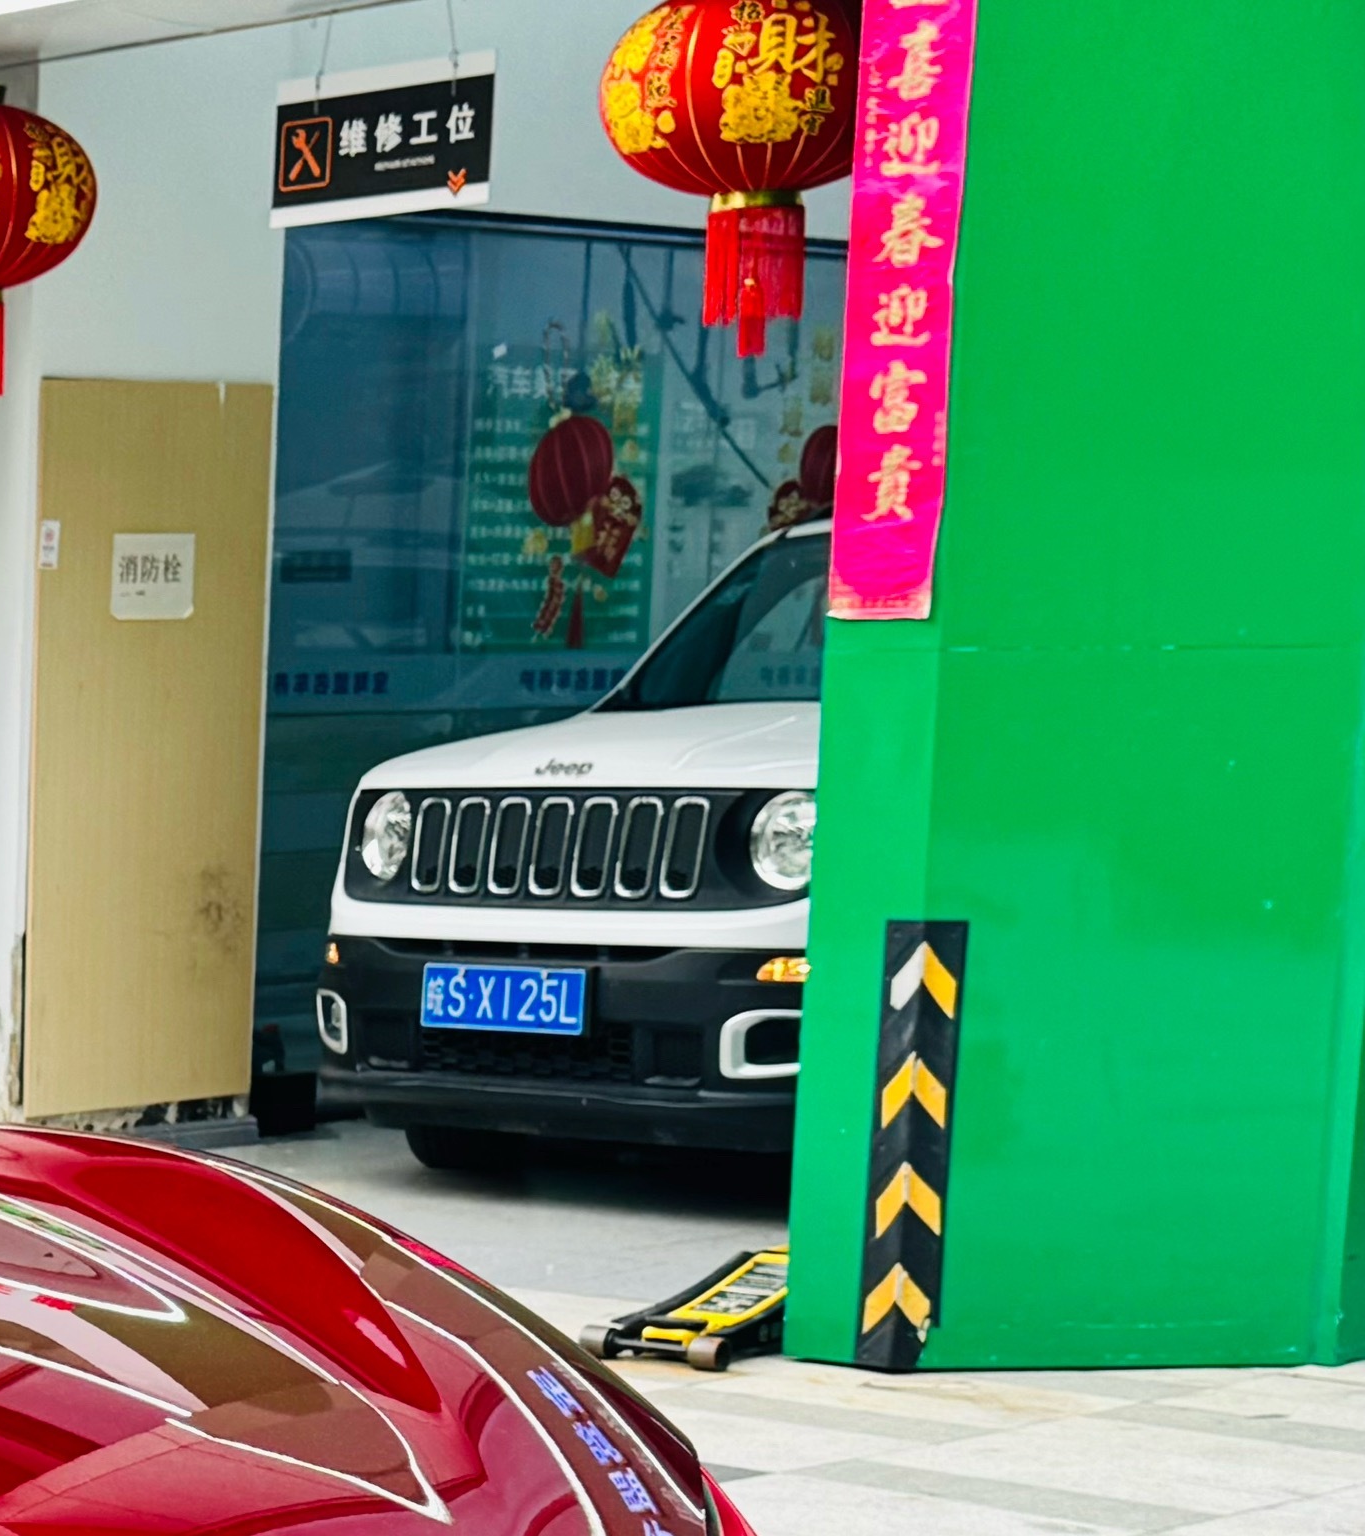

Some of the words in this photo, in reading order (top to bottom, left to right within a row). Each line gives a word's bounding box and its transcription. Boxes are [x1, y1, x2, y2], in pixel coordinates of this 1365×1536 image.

[337, 101, 476, 158] 维修工位
[119, 552, 182, 584] 消防栓
[534, 757, 594, 778] Jeep
